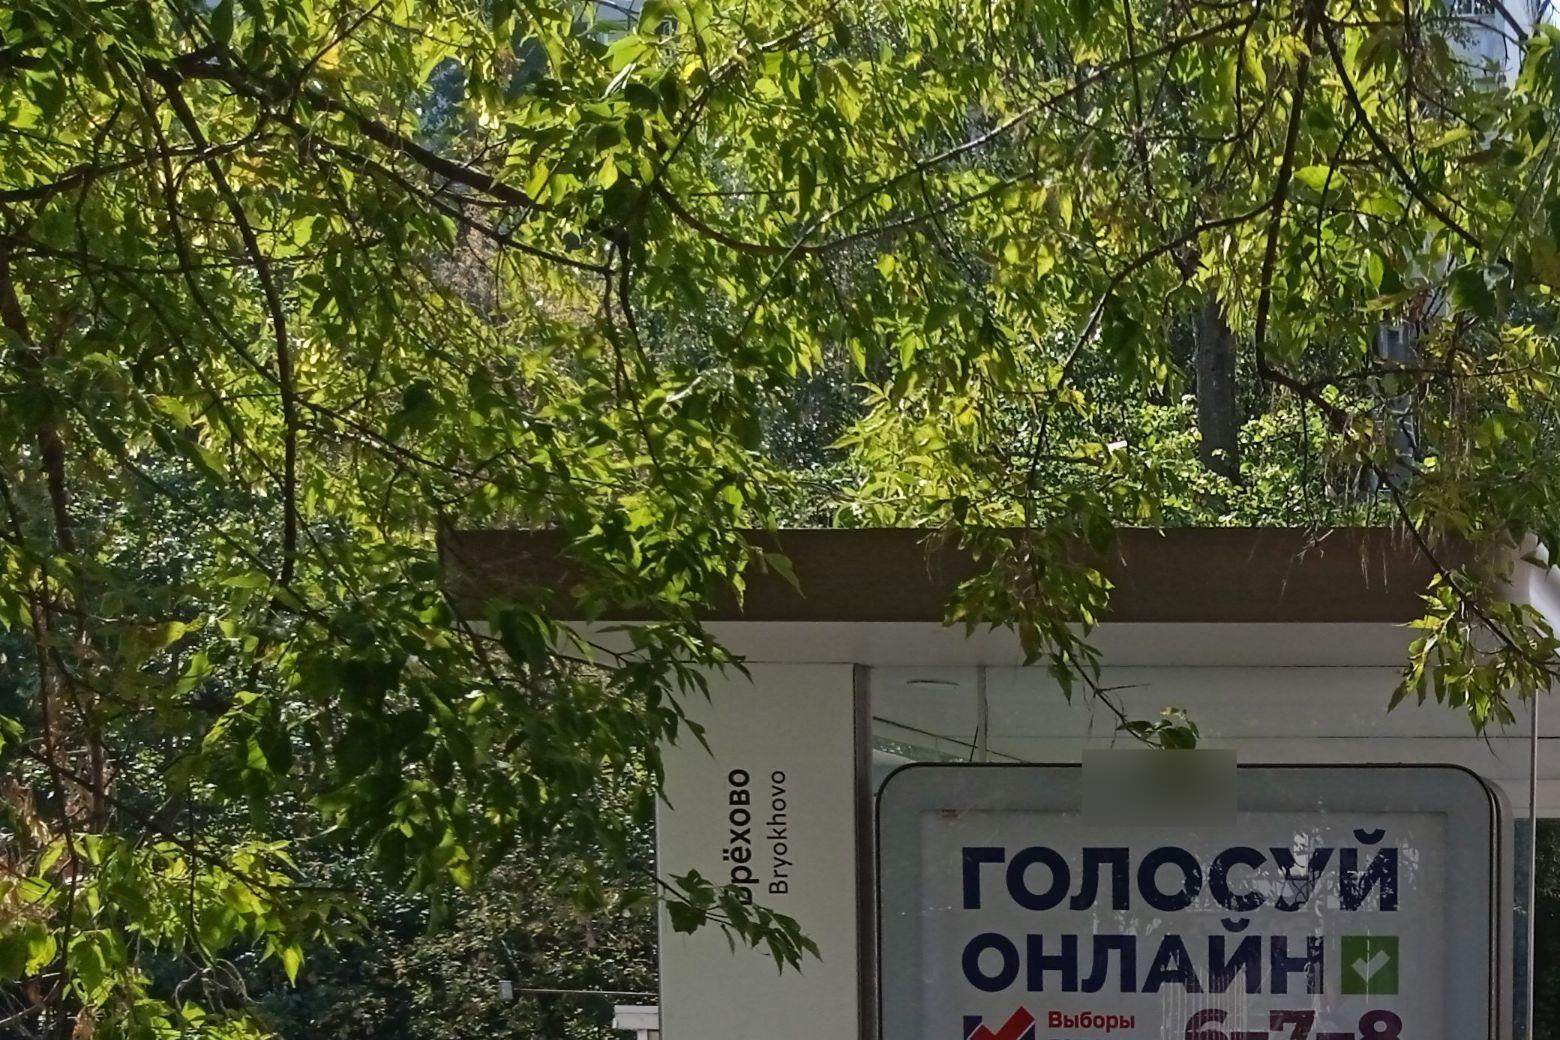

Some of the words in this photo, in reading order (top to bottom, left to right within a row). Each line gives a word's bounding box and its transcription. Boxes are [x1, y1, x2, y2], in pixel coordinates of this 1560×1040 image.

[766, 770, 792, 894] Bryokhovo
[962, 829, 1399, 912] ГОЛОСУЙ
[962, 918, 1325, 995] ОНЛАЙН
[1048, 1011, 1135, 1031] Выборы
